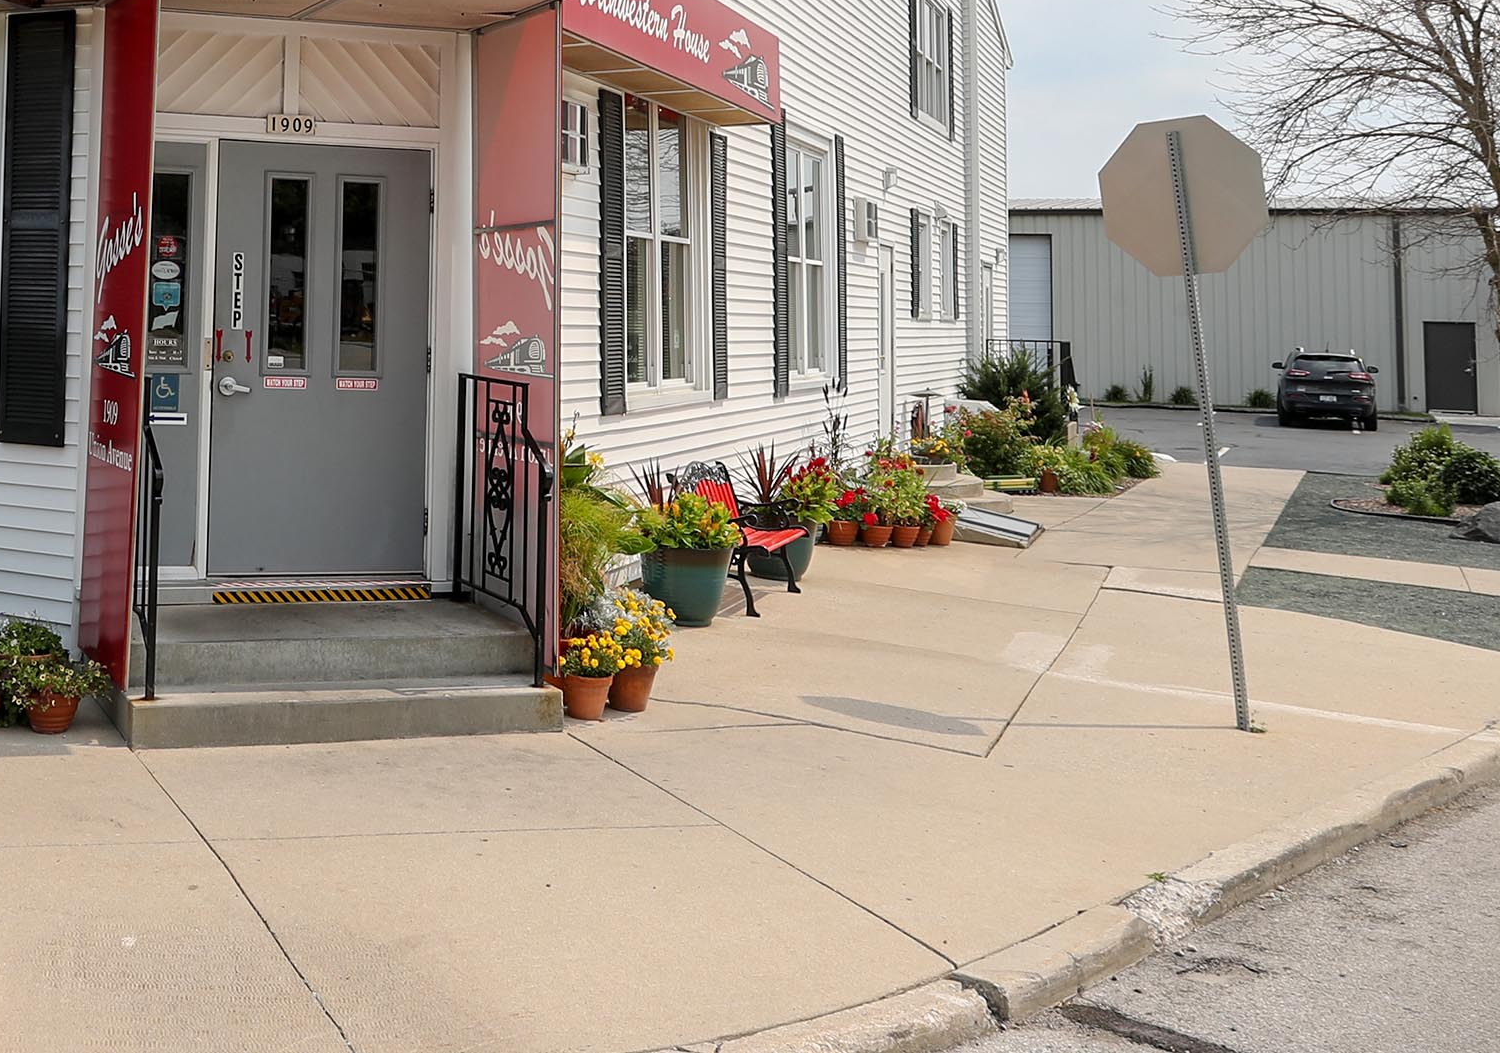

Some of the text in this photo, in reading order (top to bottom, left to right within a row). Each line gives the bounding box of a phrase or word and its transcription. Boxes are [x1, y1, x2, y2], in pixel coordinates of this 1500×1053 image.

[671, 4, 710, 64] House
[272, 116, 313, 133] 1909
[97, 191, 143, 304] Gosse's
[233, 253, 243, 328] STEP
[103, 399, 119, 425] 1909
[106, 439, 133, 472] Avenue
